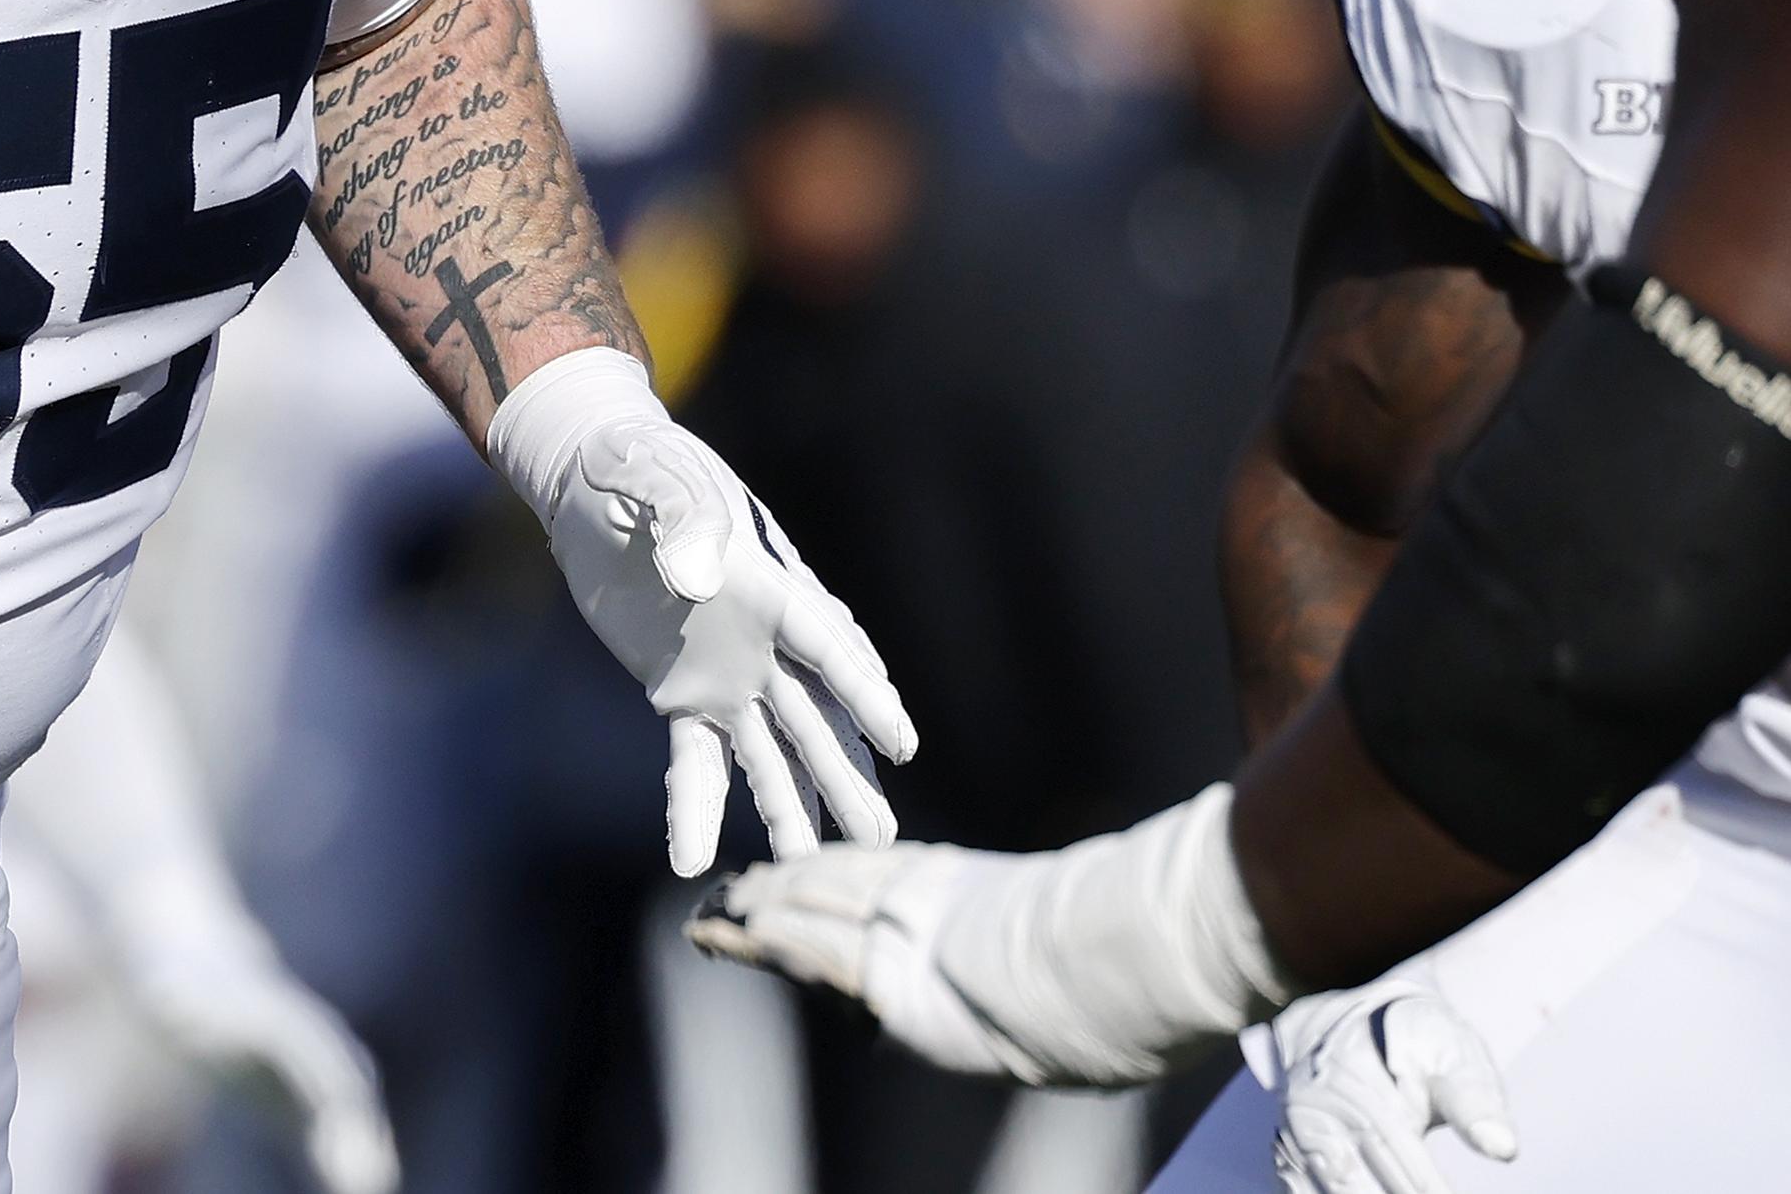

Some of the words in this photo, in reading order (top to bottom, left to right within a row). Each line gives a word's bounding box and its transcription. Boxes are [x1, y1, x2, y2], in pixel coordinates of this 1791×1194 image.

[318, 75, 428, 187] parting
[432, 53, 462, 80] is
[348, 30, 428, 106] pain
[324, 135, 415, 232] nothing
[418, 113, 453, 142] to
[459, 82, 509, 121] the
[377, 179, 409, 249] of
[409, 137, 529, 208] meeting
[404, 206, 488, 279] again
